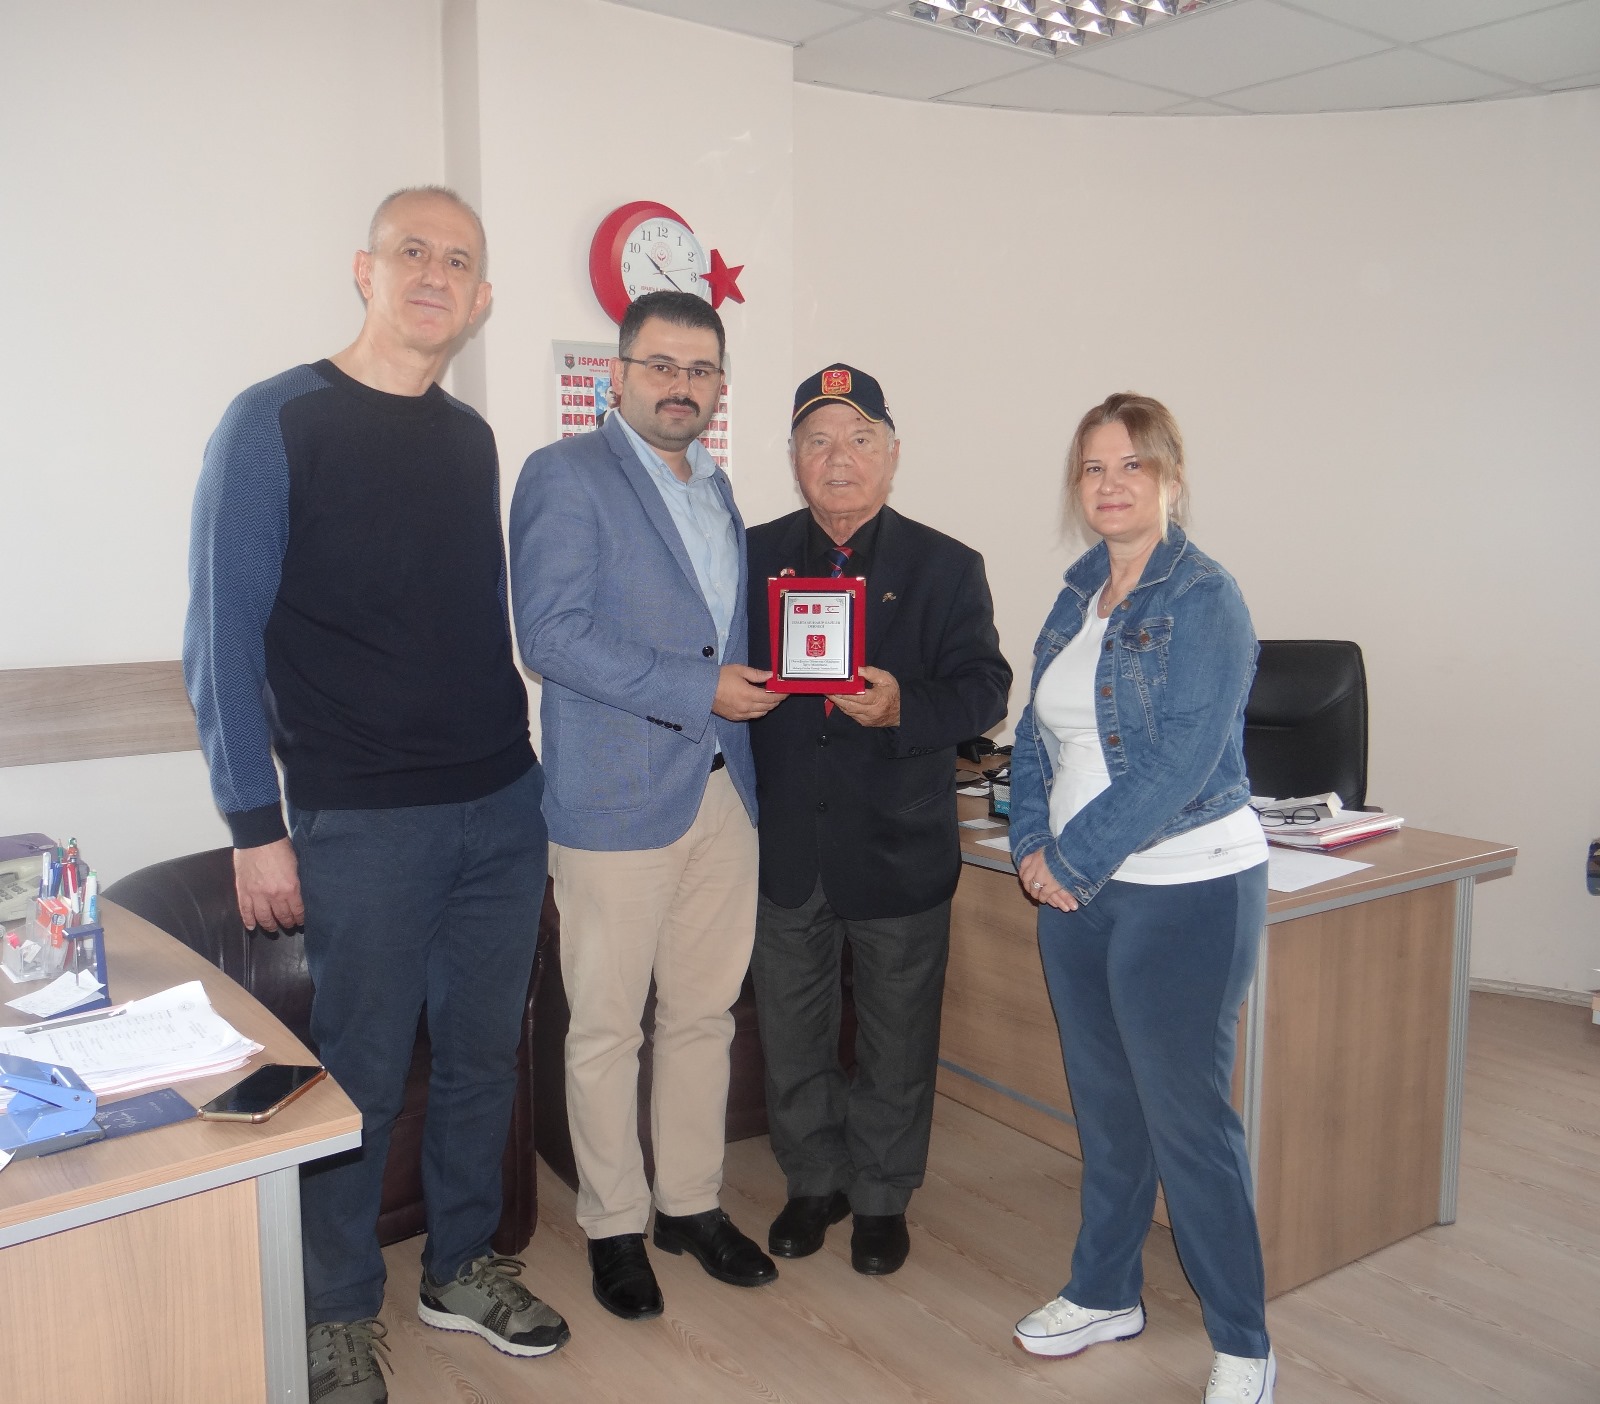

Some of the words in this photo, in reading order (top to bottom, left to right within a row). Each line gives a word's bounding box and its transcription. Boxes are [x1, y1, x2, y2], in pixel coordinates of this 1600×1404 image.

[641, 230, 652, 241] 11
[657, 227, 668, 239] 12
[677, 236, 682, 247] 1
[629, 242, 641, 254] 10
[687, 251, 695, 263] 2
[623, 262, 631, 273] 9
[690, 272, 697, 283] 3
[628, 284, 636, 296] 8
[578, 356, 610, 368] ISPART
